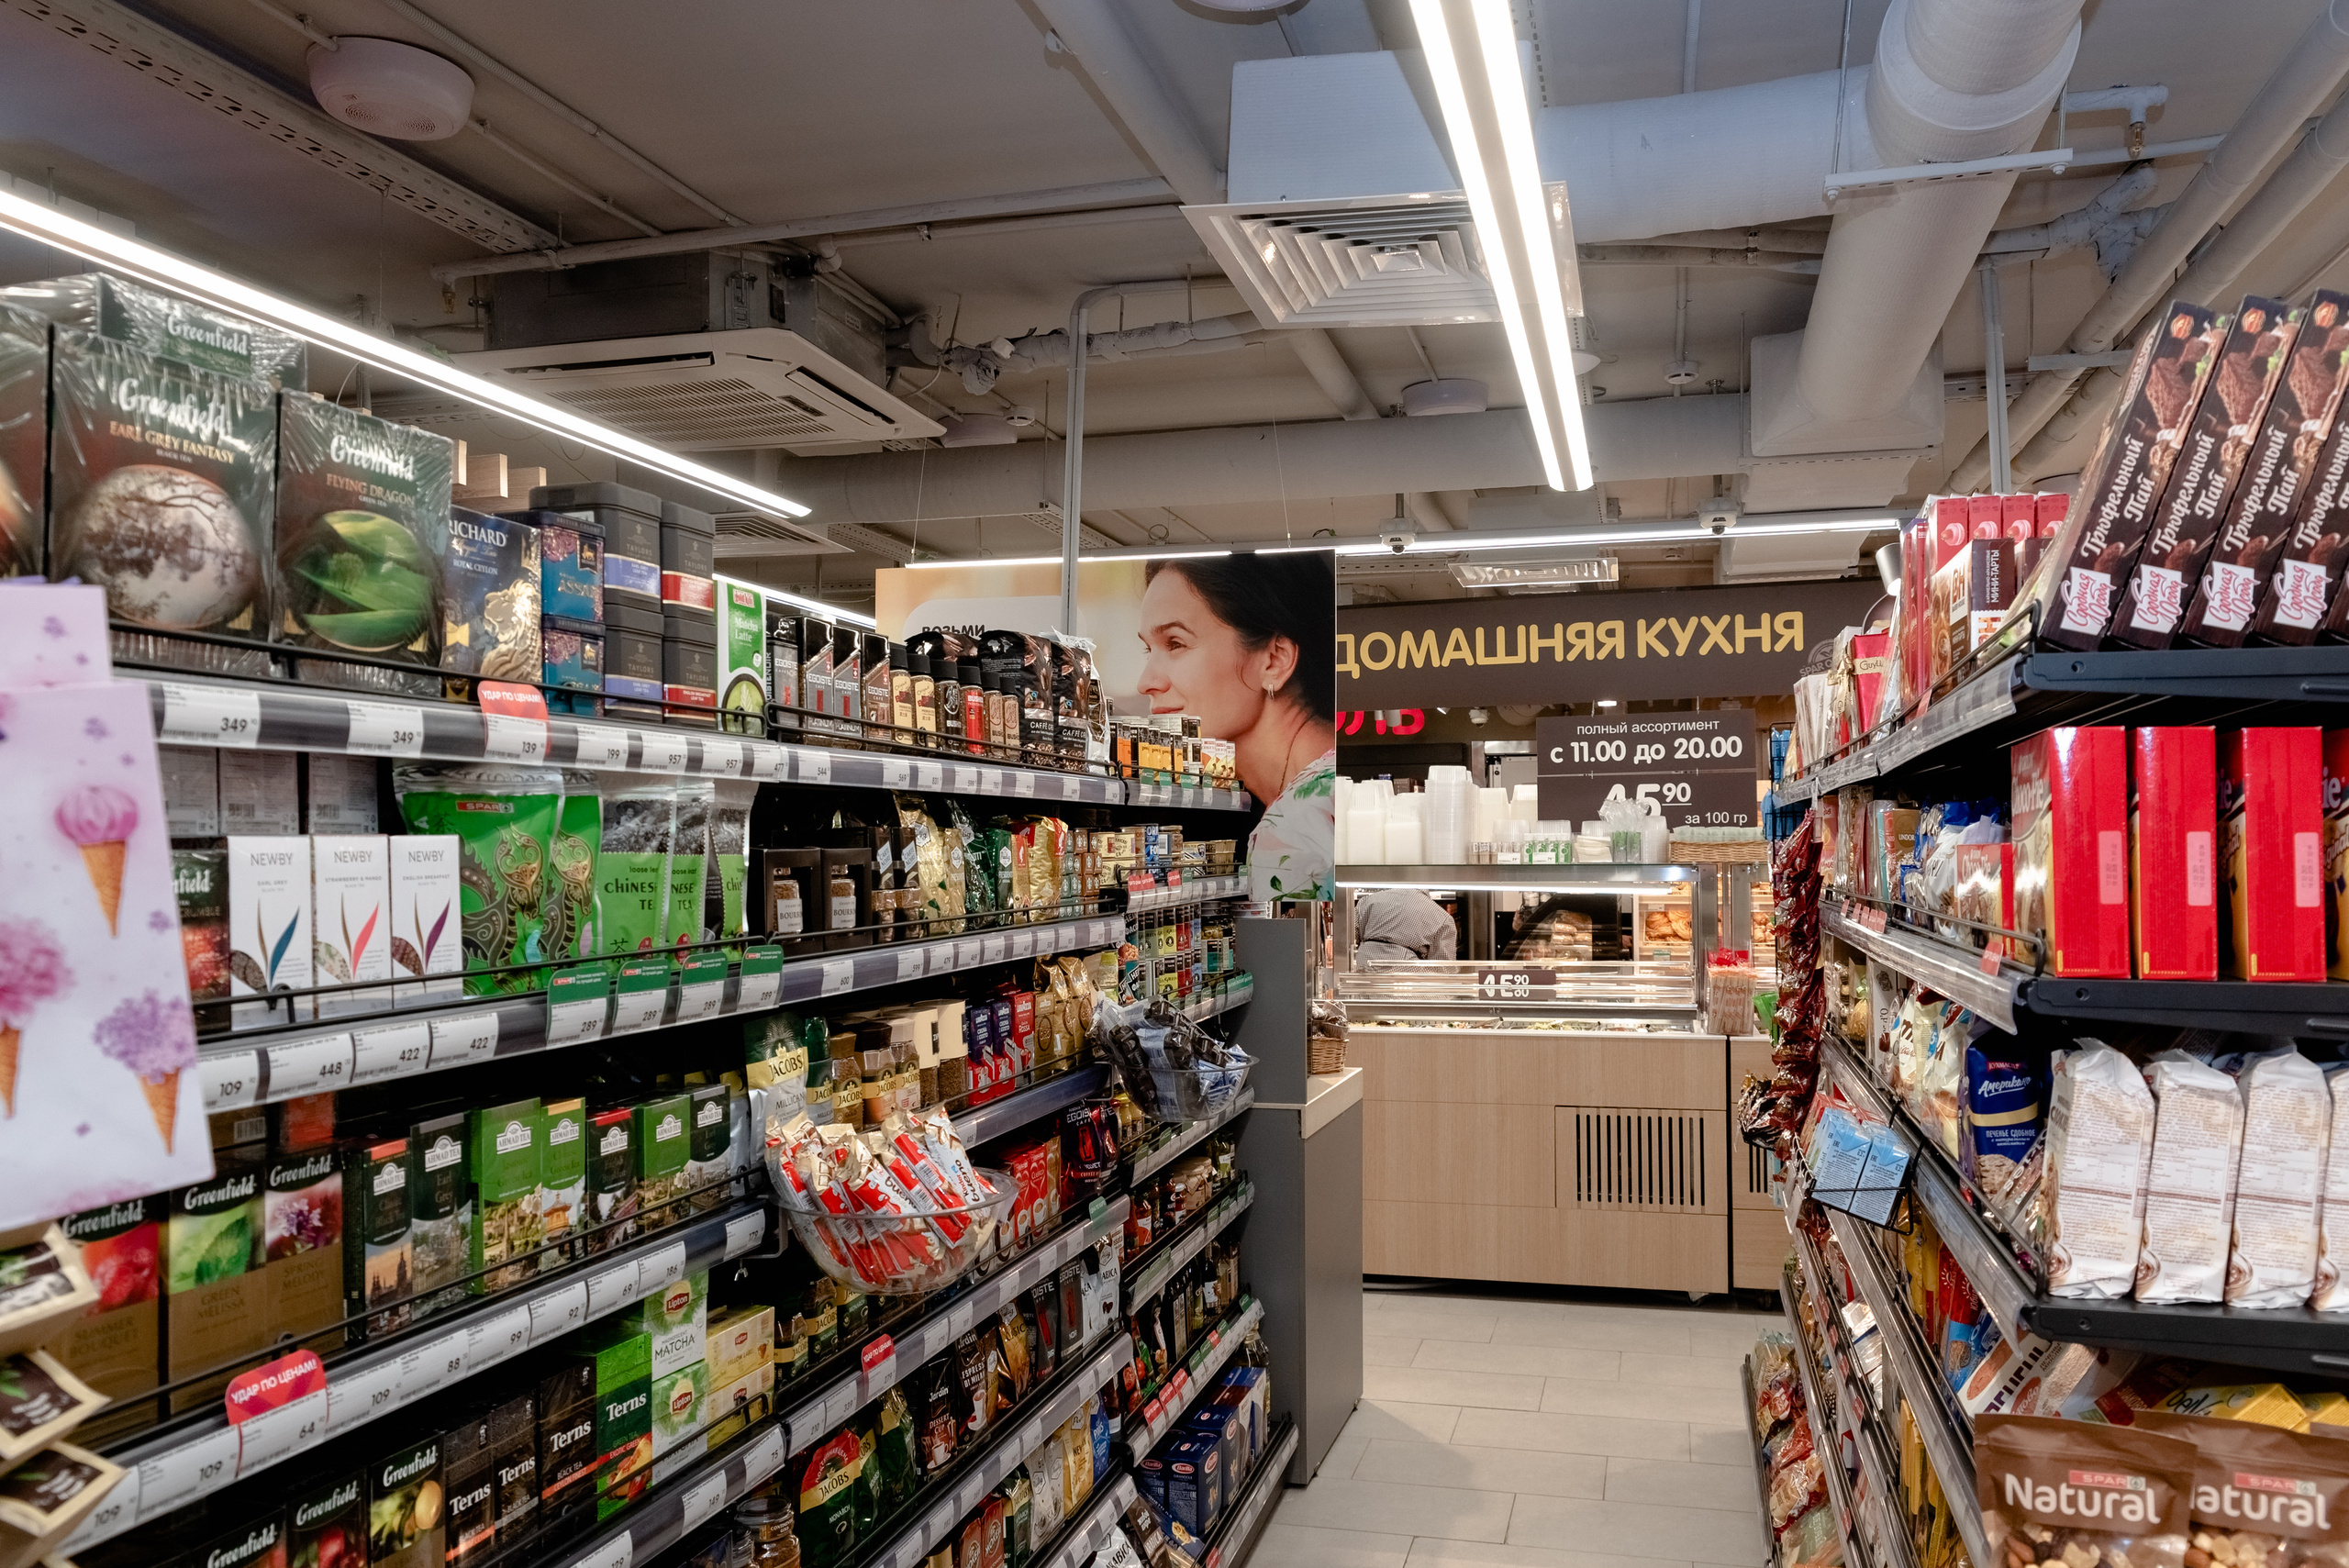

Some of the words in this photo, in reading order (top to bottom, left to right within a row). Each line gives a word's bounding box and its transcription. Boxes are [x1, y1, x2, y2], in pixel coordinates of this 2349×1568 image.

[168, 313, 250, 356] Greenfield
[119, 378, 231, 442] Greenfield
[110, 420, 143, 442] EARL
[145, 429, 183, 450] GREY
[184, 439, 235, 464] FANTASY
[327, 473, 368, 495] FLYING
[370, 484, 417, 507] DRAGON
[2080, 433, 2144, 559] Трюфельный
[2151, 429, 2215, 556] Трюфельный
[2194, 470, 2227, 519] Пай
[2222, 425, 2288, 552] Трюфельный
[2266, 466, 2299, 516] Пай
[2123, 473, 2155, 522] Пай
[627, 543, 652, 557] TAYLORS
[453, 559, 473, 571] ROYAL
[473, 562, 498, 575] CEYLON
[1990, 550, 1999, 603] МИНИ-ТАРТЫ
[734, 617, 759, 633] Matcha
[735, 631, 752, 643] Latte
[1336, 620, 1625, 679] ДОМАШНЯЯ
[1636, 610, 1804, 658] КУХНЯ
[628, 663, 654, 673] TAYLORS
[774, 658, 797, 671] EGOISTE
[1800, 664, 1824, 677] SPAR
[685, 673, 709, 683] TAYLORS
[808, 673, 832, 686] EGOISTE
[835, 679, 859, 692] EGOISTE
[482, 689, 501, 702] УДАР
[503, 692, 514, 702] ПО
[514, 693, 541, 704] ЦЕНАМ!
[868, 685, 889, 697] EGOISTE
[220, 717, 249, 733] 349
[1576, 721, 1628, 737] полный
[1631, 718, 1720, 734] ассортимент
[393, 731, 414, 744] 349
[522, 741, 537, 754] 139
[607, 748, 620, 760] 199
[1550, 746, 1564, 763] с
[1570, 739, 1627, 763] 11.00
[1633, 743, 1666, 764] до
[1674, 736, 1743, 760] 20.00
[669, 754, 682, 765] 957
[726, 760, 738, 769] 957
[774, 763, 785, 773] 477
[817, 768, 828, 776] 544
[1662, 782, 1691, 803] 90
[466, 803, 500, 812] SPAR
[1685, 814, 1701, 825] за
[1705, 812, 1730, 825] 100
[1733, 812, 1748, 828] гр
[250, 852, 294, 866] NEWBY
[333, 851, 373, 863] NEWBY
[407, 850, 445, 862] NEWBY
[629, 865, 649, 873] loose
[677, 899, 693, 911] TEA
[841, 975, 850, 986] 600
[761, 992, 772, 1001] 289
[704, 1001, 716, 1012] 289
[642, 1011, 656, 1022] 289
[581, 1020, 596, 1033] 289
[1019, 1024, 1030, 1034] ROSSA
[470, 1036, 488, 1051] 422
[399, 1047, 419, 1062] 422
[319, 1062, 342, 1078] 448
[769, 1055, 804, 1082] JACOBS
[219, 1081, 242, 1097] 109
[876, 1079, 896, 1096] JACOBS
[1978, 1076, 2032, 1098] Американо
[838, 1090, 863, 1107] JACOBS
[698, 1113, 713, 1123] AHMAD
[714, 1110, 722, 1118] TEA
[845, 1109, 858, 1118] GOLD
[551, 1130, 569, 1141] AHMAD
[569, 1128, 579, 1137] TEA
[657, 1127, 672, 1138] AHMAD
[673, 1123, 681, 1133] TEA
[1986, 1129, 2009, 1139] ПЕЧЕНЬЕ
[2010, 1129, 2036, 1138] СДОБНОЕ
[498, 1136, 519, 1149] AHMAD
[519, 1132, 530, 1143] TEA
[602, 1140, 618, 1151] AHMAD
[618, 1137, 628, 1146] TEA
[426, 1151, 449, 1165] AHMAD
[450, 1147, 461, 1159] TEA
[269, 1154, 331, 1187] Greenfield
[374, 1177, 395, 1190] AHMAD
[395, 1173, 404, 1184] TEA
[437, 1173, 452, 1186] Earl
[955, 1159, 980, 1203] bueno
[184, 1174, 255, 1210] Greenfield
[435, 1192, 453, 1205] Grey
[61, 1200, 145, 1238] Greenfield
[666, 1264, 678, 1277] 186
[622, 1283, 632, 1296] 69
[668, 1296, 688, 1309] Lipton
[569, 1306, 579, 1319] 92
[510, 1331, 522, 1345] 99
[735, 1333, 748, 1345] Lipton
[1069, 1330, 1078, 1340] NOIR
[654, 1334, 696, 1362] MATCHA
[743, 1349, 754, 1359] LABEL
[447, 1358, 460, 1374] 88
[231, 1381, 261, 1405] УДАР
[261, 1373, 276, 1392] ПО
[277, 1358, 317, 1385] ЦЕНАМ!
[371, 1389, 391, 1407] 109
[674, 1393, 692, 1409] Lipton
[930, 1386, 949, 1403] Jardin
[607, 1393, 647, 1422] Terns
[930, 1413, 950, 1429] DESSERT
[299, 1423, 316, 1440] 64
[551, 1420, 592, 1453] Terns
[629, 1430, 639, 1441] TEA
[934, 1424, 945, 1434] CUP
[610, 1445, 626, 1460] EXOTIC
[771, 1450, 779, 1462] 75
[199, 1461, 223, 1480] 109
[383, 1444, 437, 1488] Greenfield
[498, 1455, 536, 1486] Terns
[556, 1466, 573, 1481] BLACK
[573, 1461, 584, 1472] TEA
[818, 1472, 850, 1501] JACOBS
[2083, 1473, 2127, 1487] SPAR
[2250, 1477, 2297, 1491] SPAR
[295, 1479, 358, 1528] Greenfield
[449, 1483, 492, 1517] Terns
[520, 1495, 530, 1506] TEA
[708, 1495, 720, 1510] 149
[2005, 1473, 2161, 1525] Natural
[94, 1506, 121, 1526] 109
[829, 1504, 851, 1524] MONARCH
[476, 1523, 485, 1533] TEA
[207, 1522, 276, 1568] Greenfield
